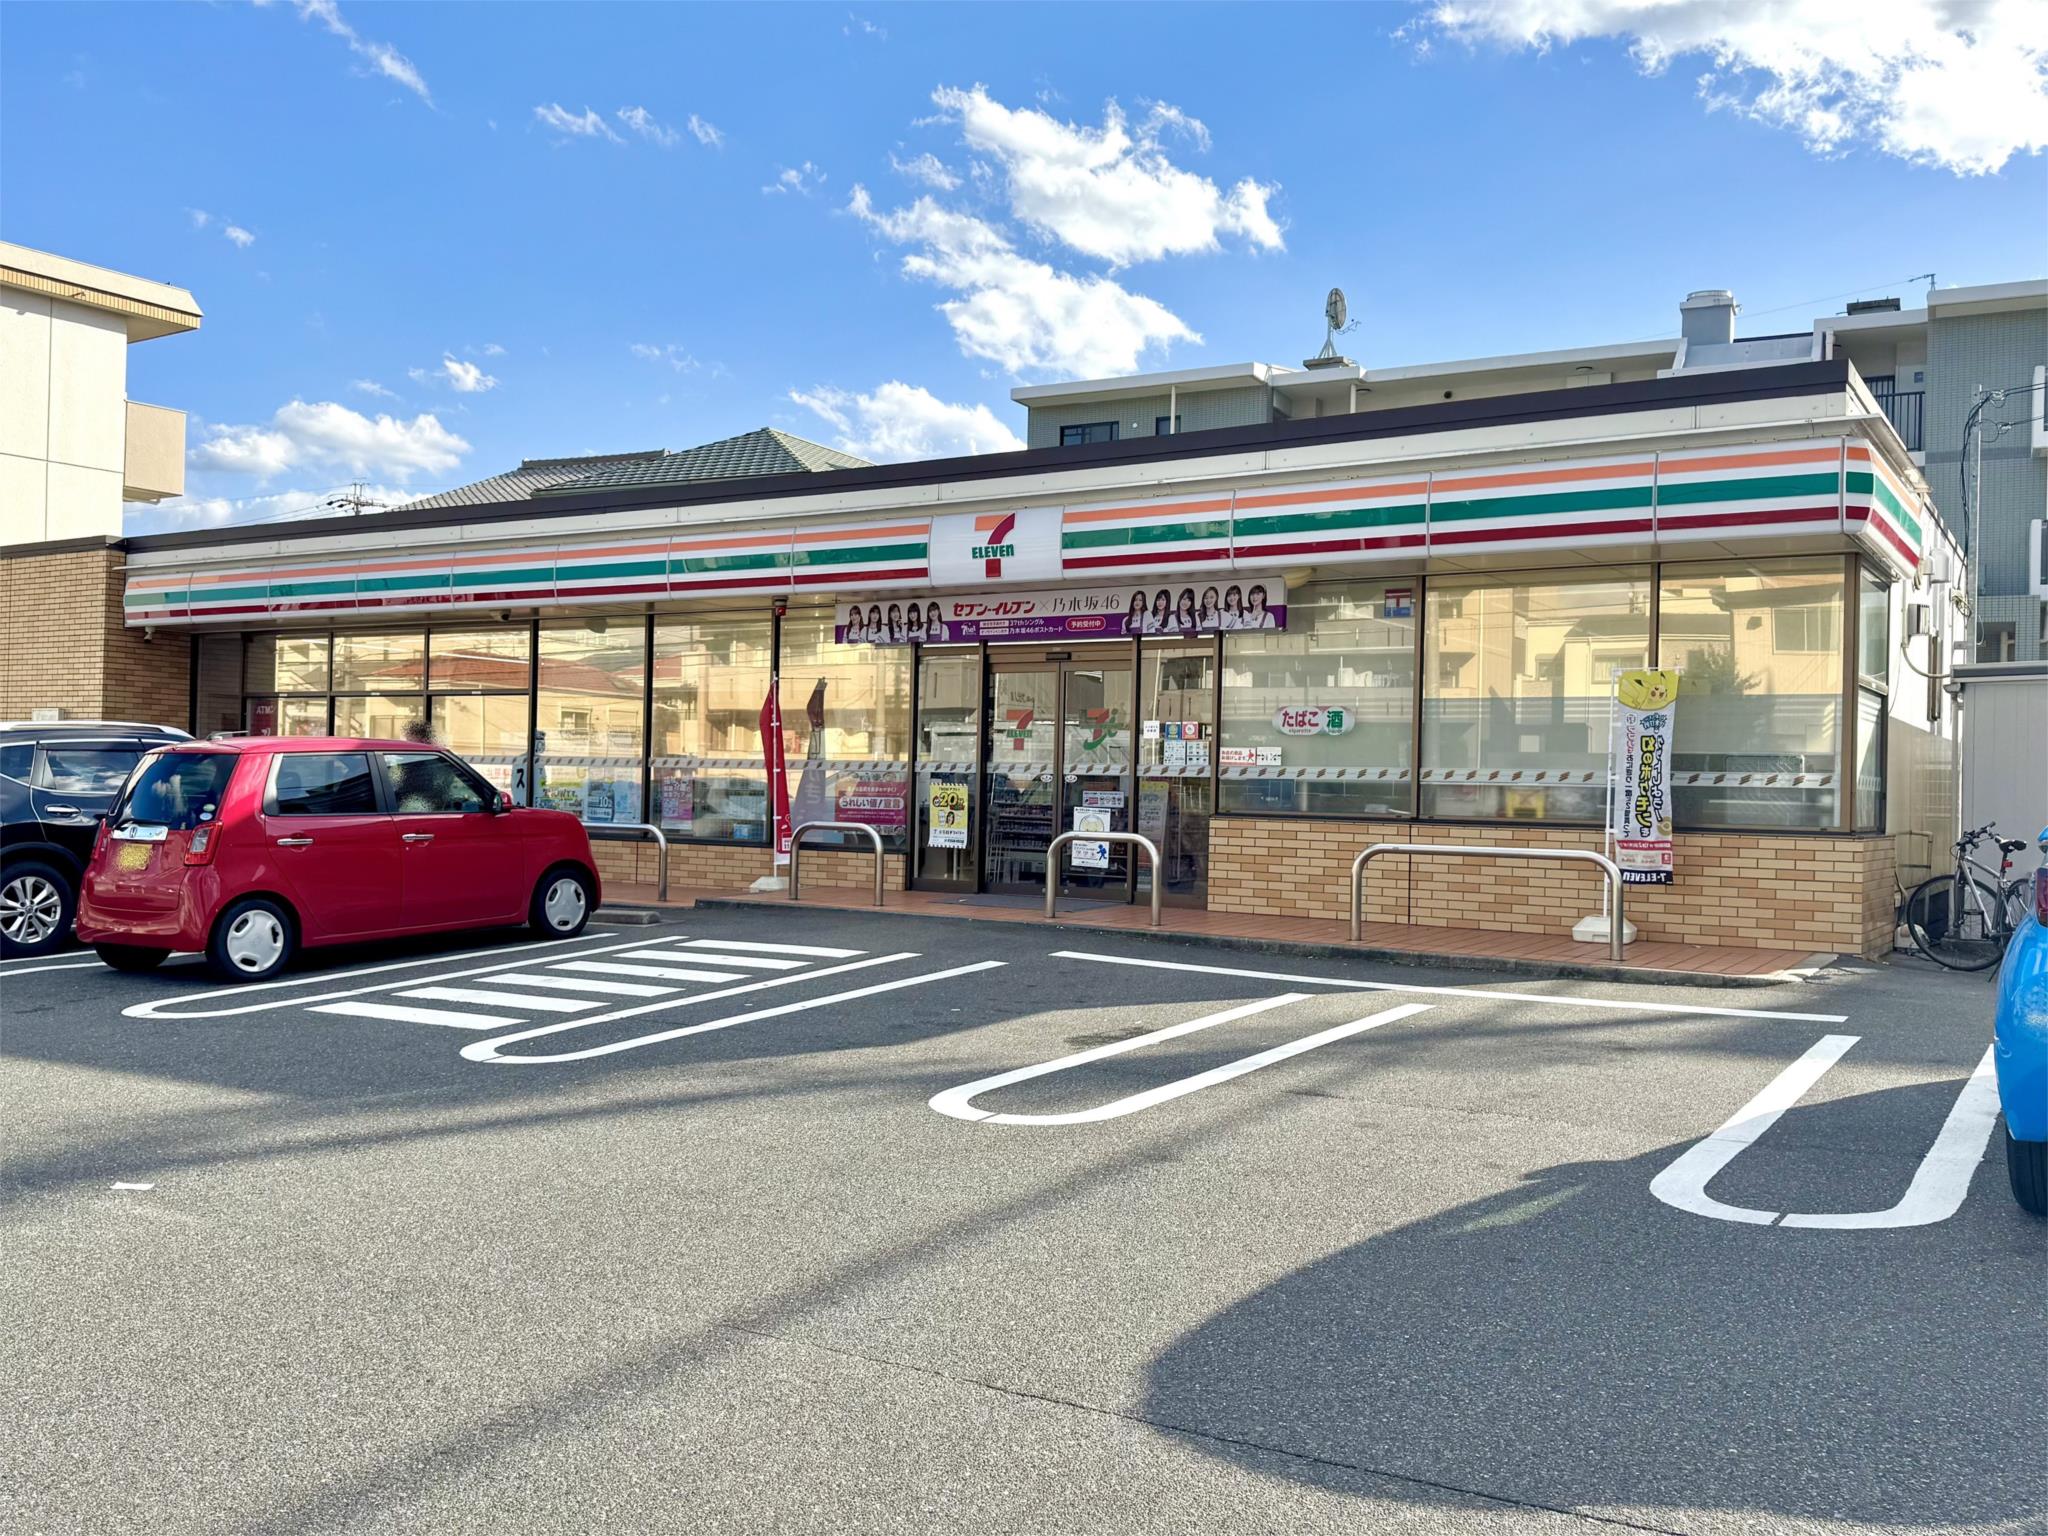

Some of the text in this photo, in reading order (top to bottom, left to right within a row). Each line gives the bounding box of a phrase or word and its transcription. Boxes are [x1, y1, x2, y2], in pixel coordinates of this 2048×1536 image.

[1282, 710, 1344, 728] たばこ 酒
